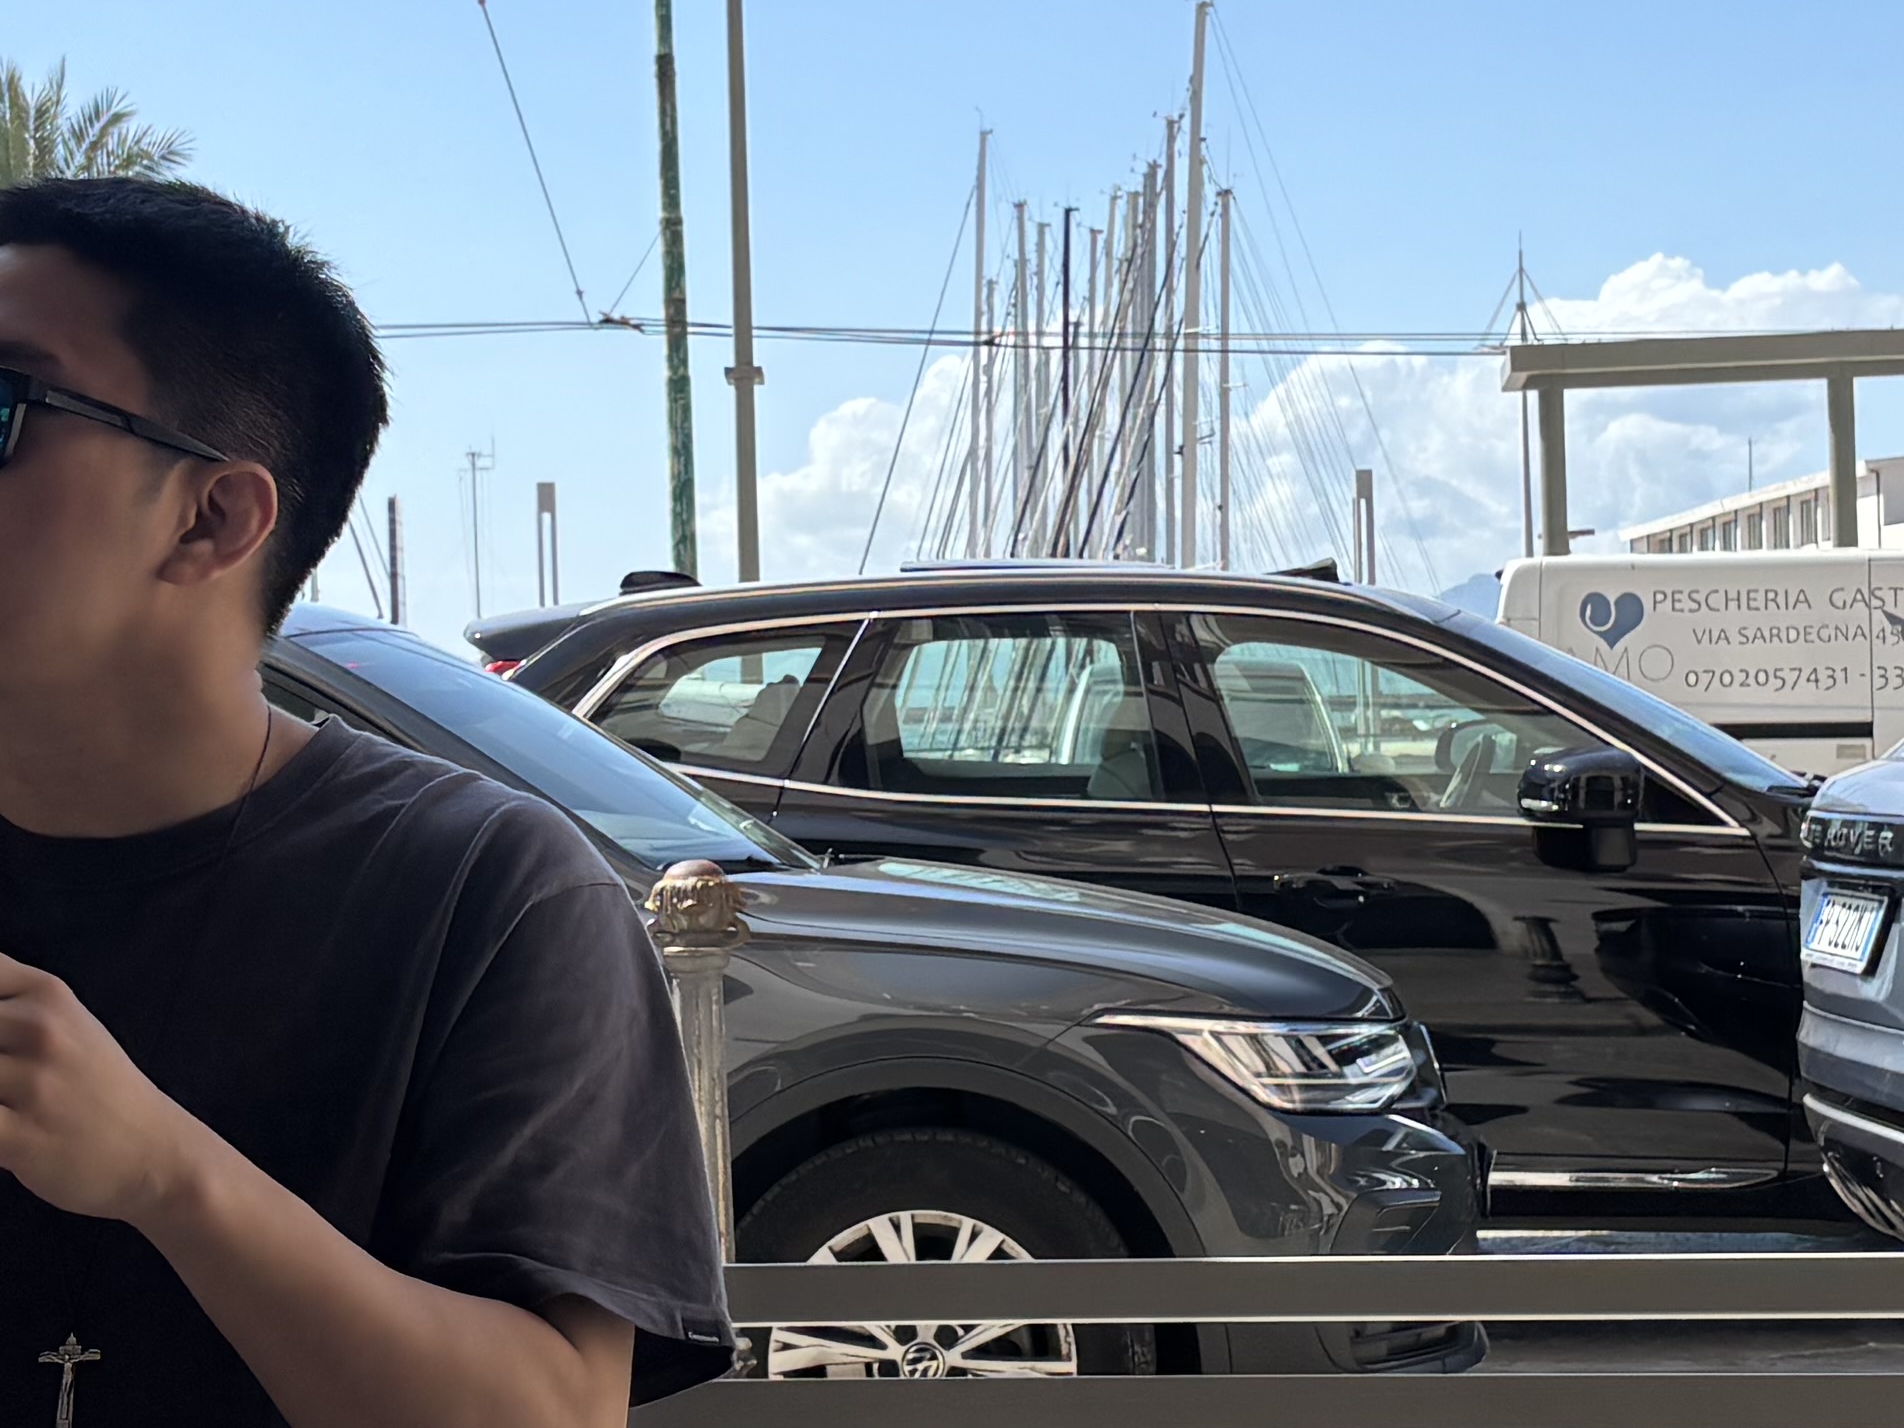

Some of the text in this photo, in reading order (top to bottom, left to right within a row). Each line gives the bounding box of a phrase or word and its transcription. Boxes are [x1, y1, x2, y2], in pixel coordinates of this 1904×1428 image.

[1652, 588, 1812, 613] PESCHERIA
[1693, 627, 1731, 645] VIA
[1737, 624, 1868, 645] SARDEGNA
[1566, 644, 1674, 682] MO
[1684, 666, 1849, 692] 0702057431
